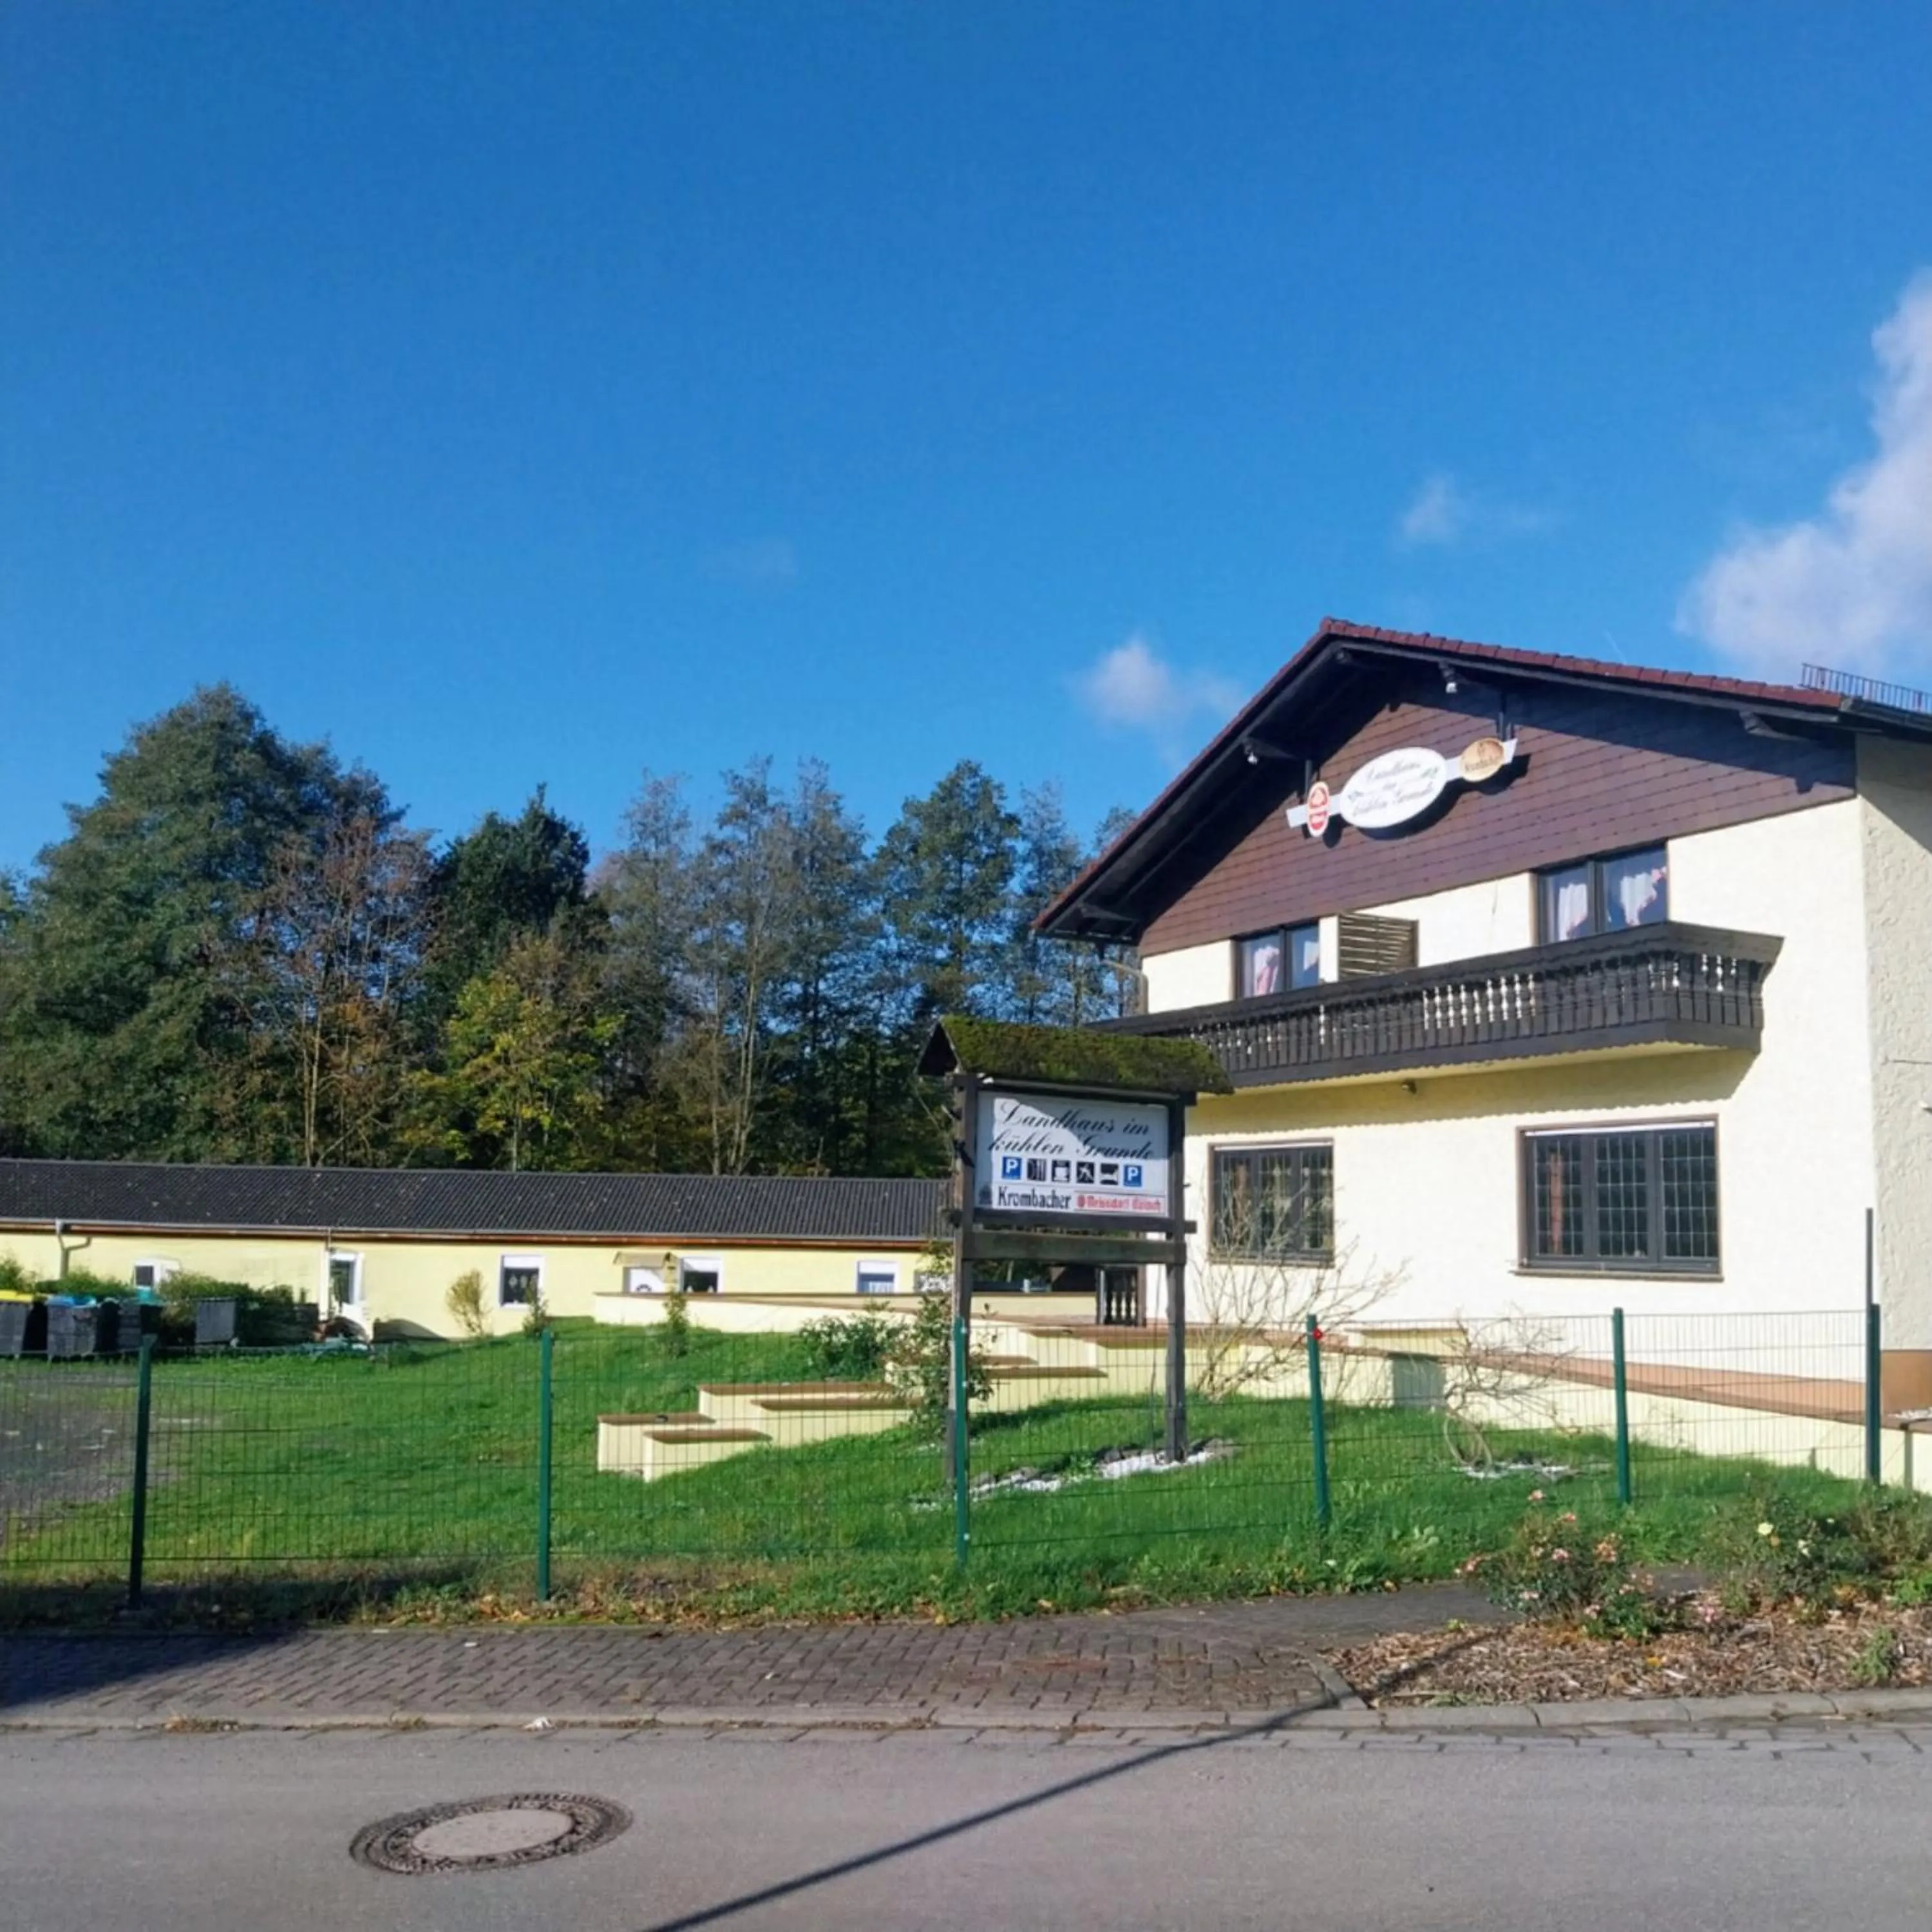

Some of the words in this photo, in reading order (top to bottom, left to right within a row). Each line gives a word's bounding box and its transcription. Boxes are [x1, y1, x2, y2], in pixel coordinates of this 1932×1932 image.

[999, 1101, 1115, 1133] Landhaus
[1122, 1117, 1150, 1135] im
[998, 1185, 1072, 1209] Krombacher
